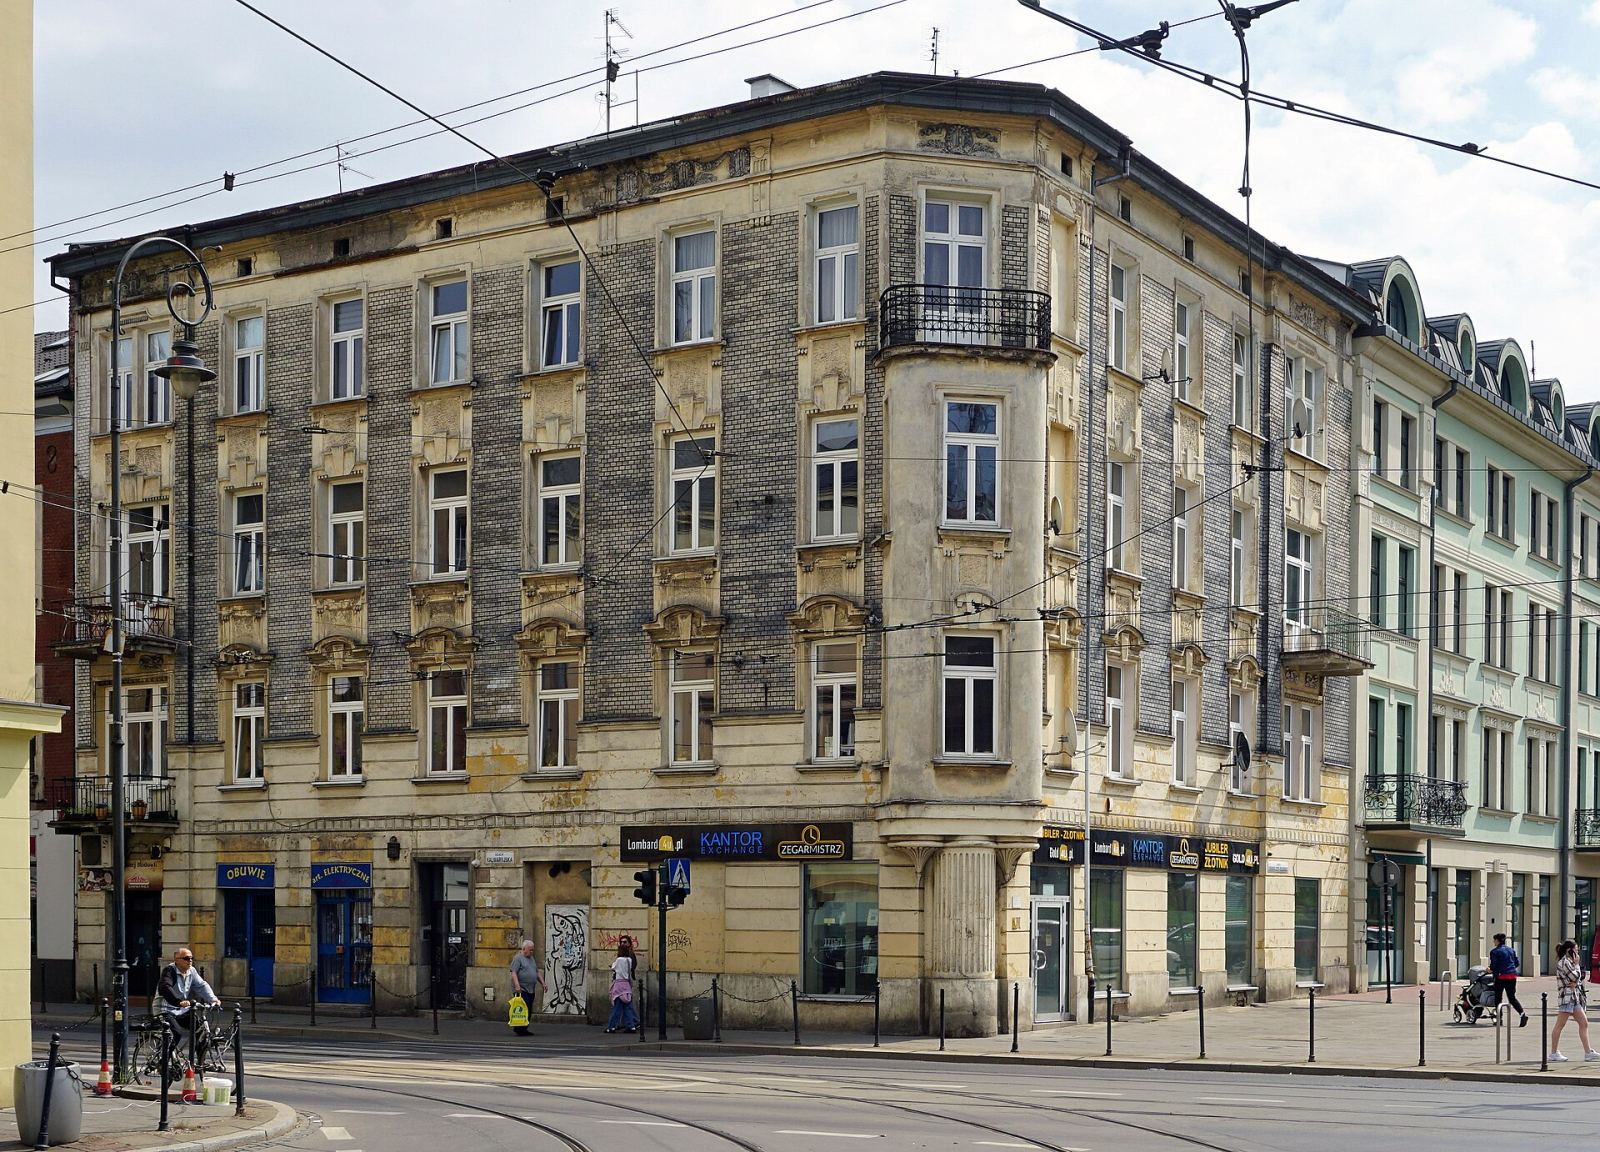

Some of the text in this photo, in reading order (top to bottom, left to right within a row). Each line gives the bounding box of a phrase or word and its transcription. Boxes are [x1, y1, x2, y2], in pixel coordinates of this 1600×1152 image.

[700, 832, 763, 846] KANTOR
[1043, 828, 1060, 839] BILER
[700, 846, 763, 854] EXCHANGE
[781, 844, 842, 855] ZEGARMISTRZ
[1133, 839, 1164, 855] KANTOR
[1205, 842, 1229, 854] JUBILER
[1133, 853, 1164, 862] EXCHANGE
[1172, 855, 1198, 865] ZEGARMISTRZ
[1204, 856, 1229, 869] ZŁOTNIK
[226, 866, 266, 880] OBUWIE
[323, 865, 370, 883] ELEKTRYCZNE
